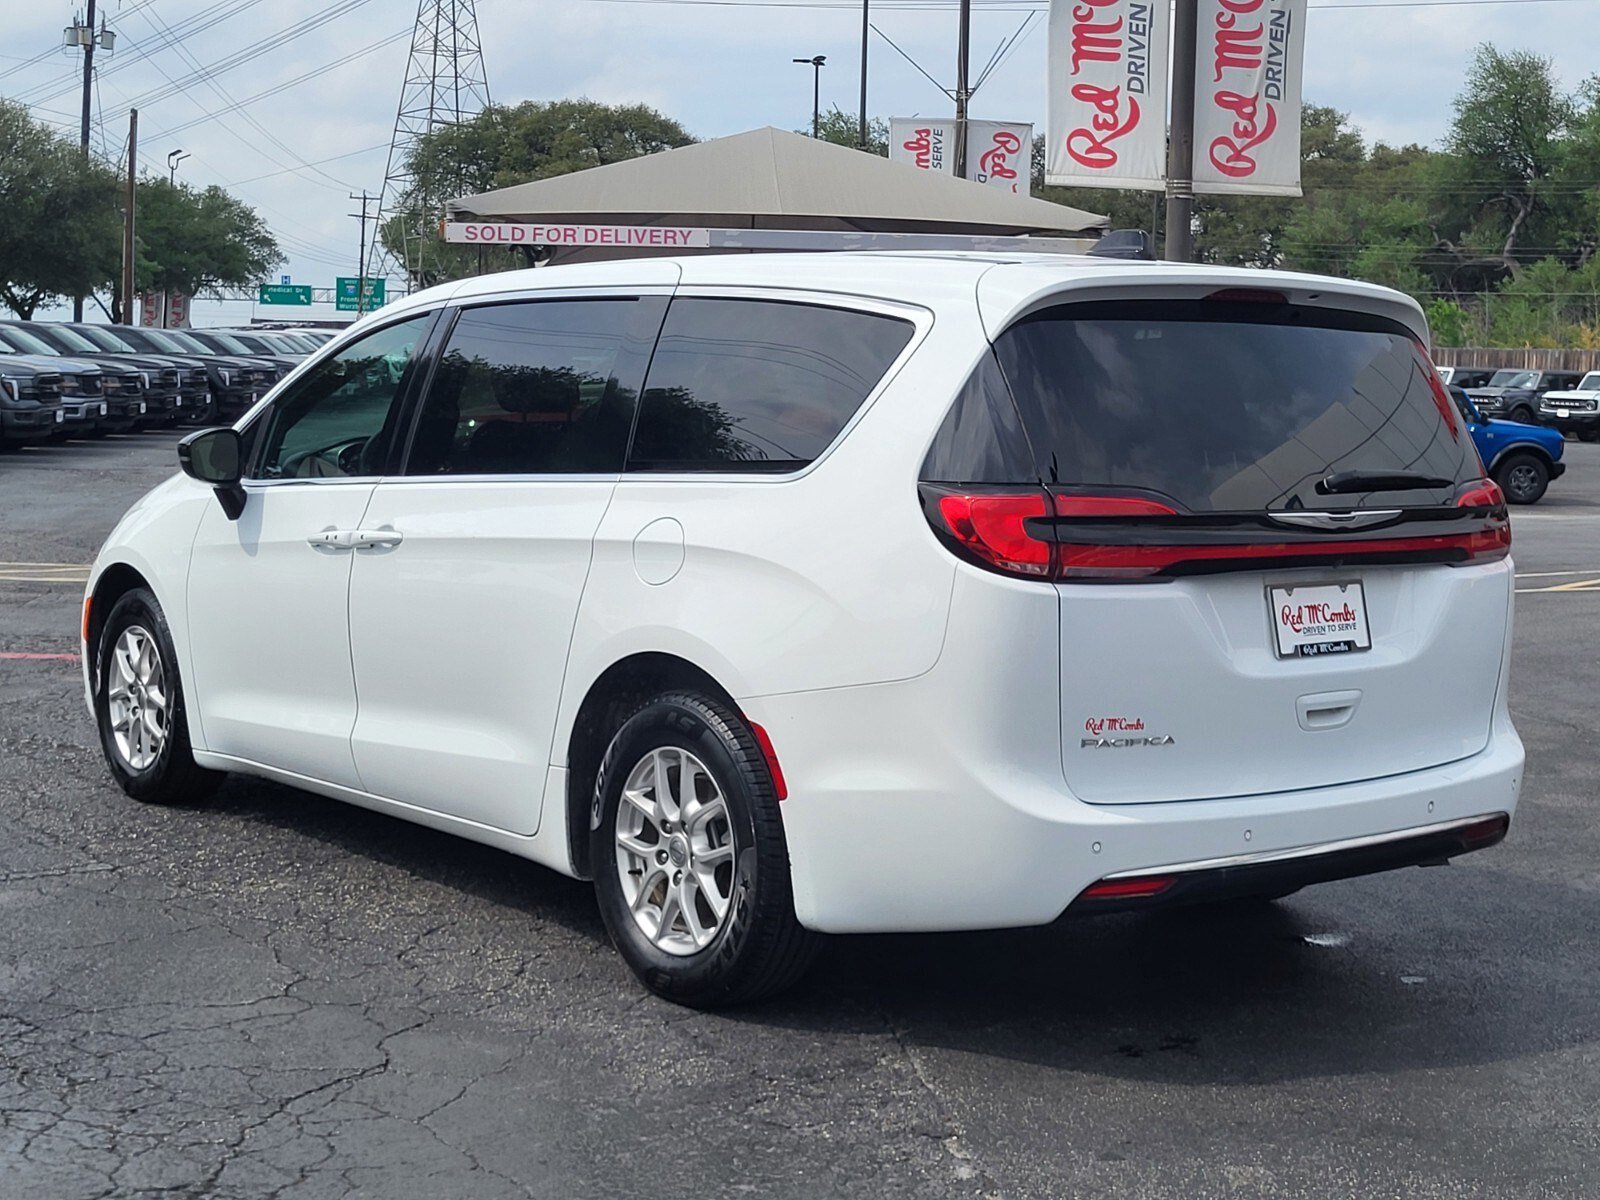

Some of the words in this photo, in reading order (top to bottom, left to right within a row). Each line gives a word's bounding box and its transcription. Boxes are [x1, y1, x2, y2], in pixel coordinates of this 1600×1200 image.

[1127, 3, 1148, 94] DRIVEN
[1265, 9, 1286, 100] DRIVEN
[1066, 83, 1140, 169] Red
[1209, 90, 1277, 177] Red
[932, 128, 943, 169] SERVE
[980, 131, 1021, 179] Red
[465, 225, 525, 242] SOLD
[532, 227, 577, 243] FOR
[584, 228, 692, 245] DELIVERY
[1281, 604, 1304, 633] Red
[1304, 602, 1356, 624] McCombs
[1303, 625, 1326, 635] DRIVEN
[1327, 624, 1337, 633] TO
[1338, 622, 1357, 632] SERVE
[1080, 734, 1176, 749] PACIFICA
[1085, 717, 1104, 735] Red
[1105, 717, 1145, 731] McCombs
